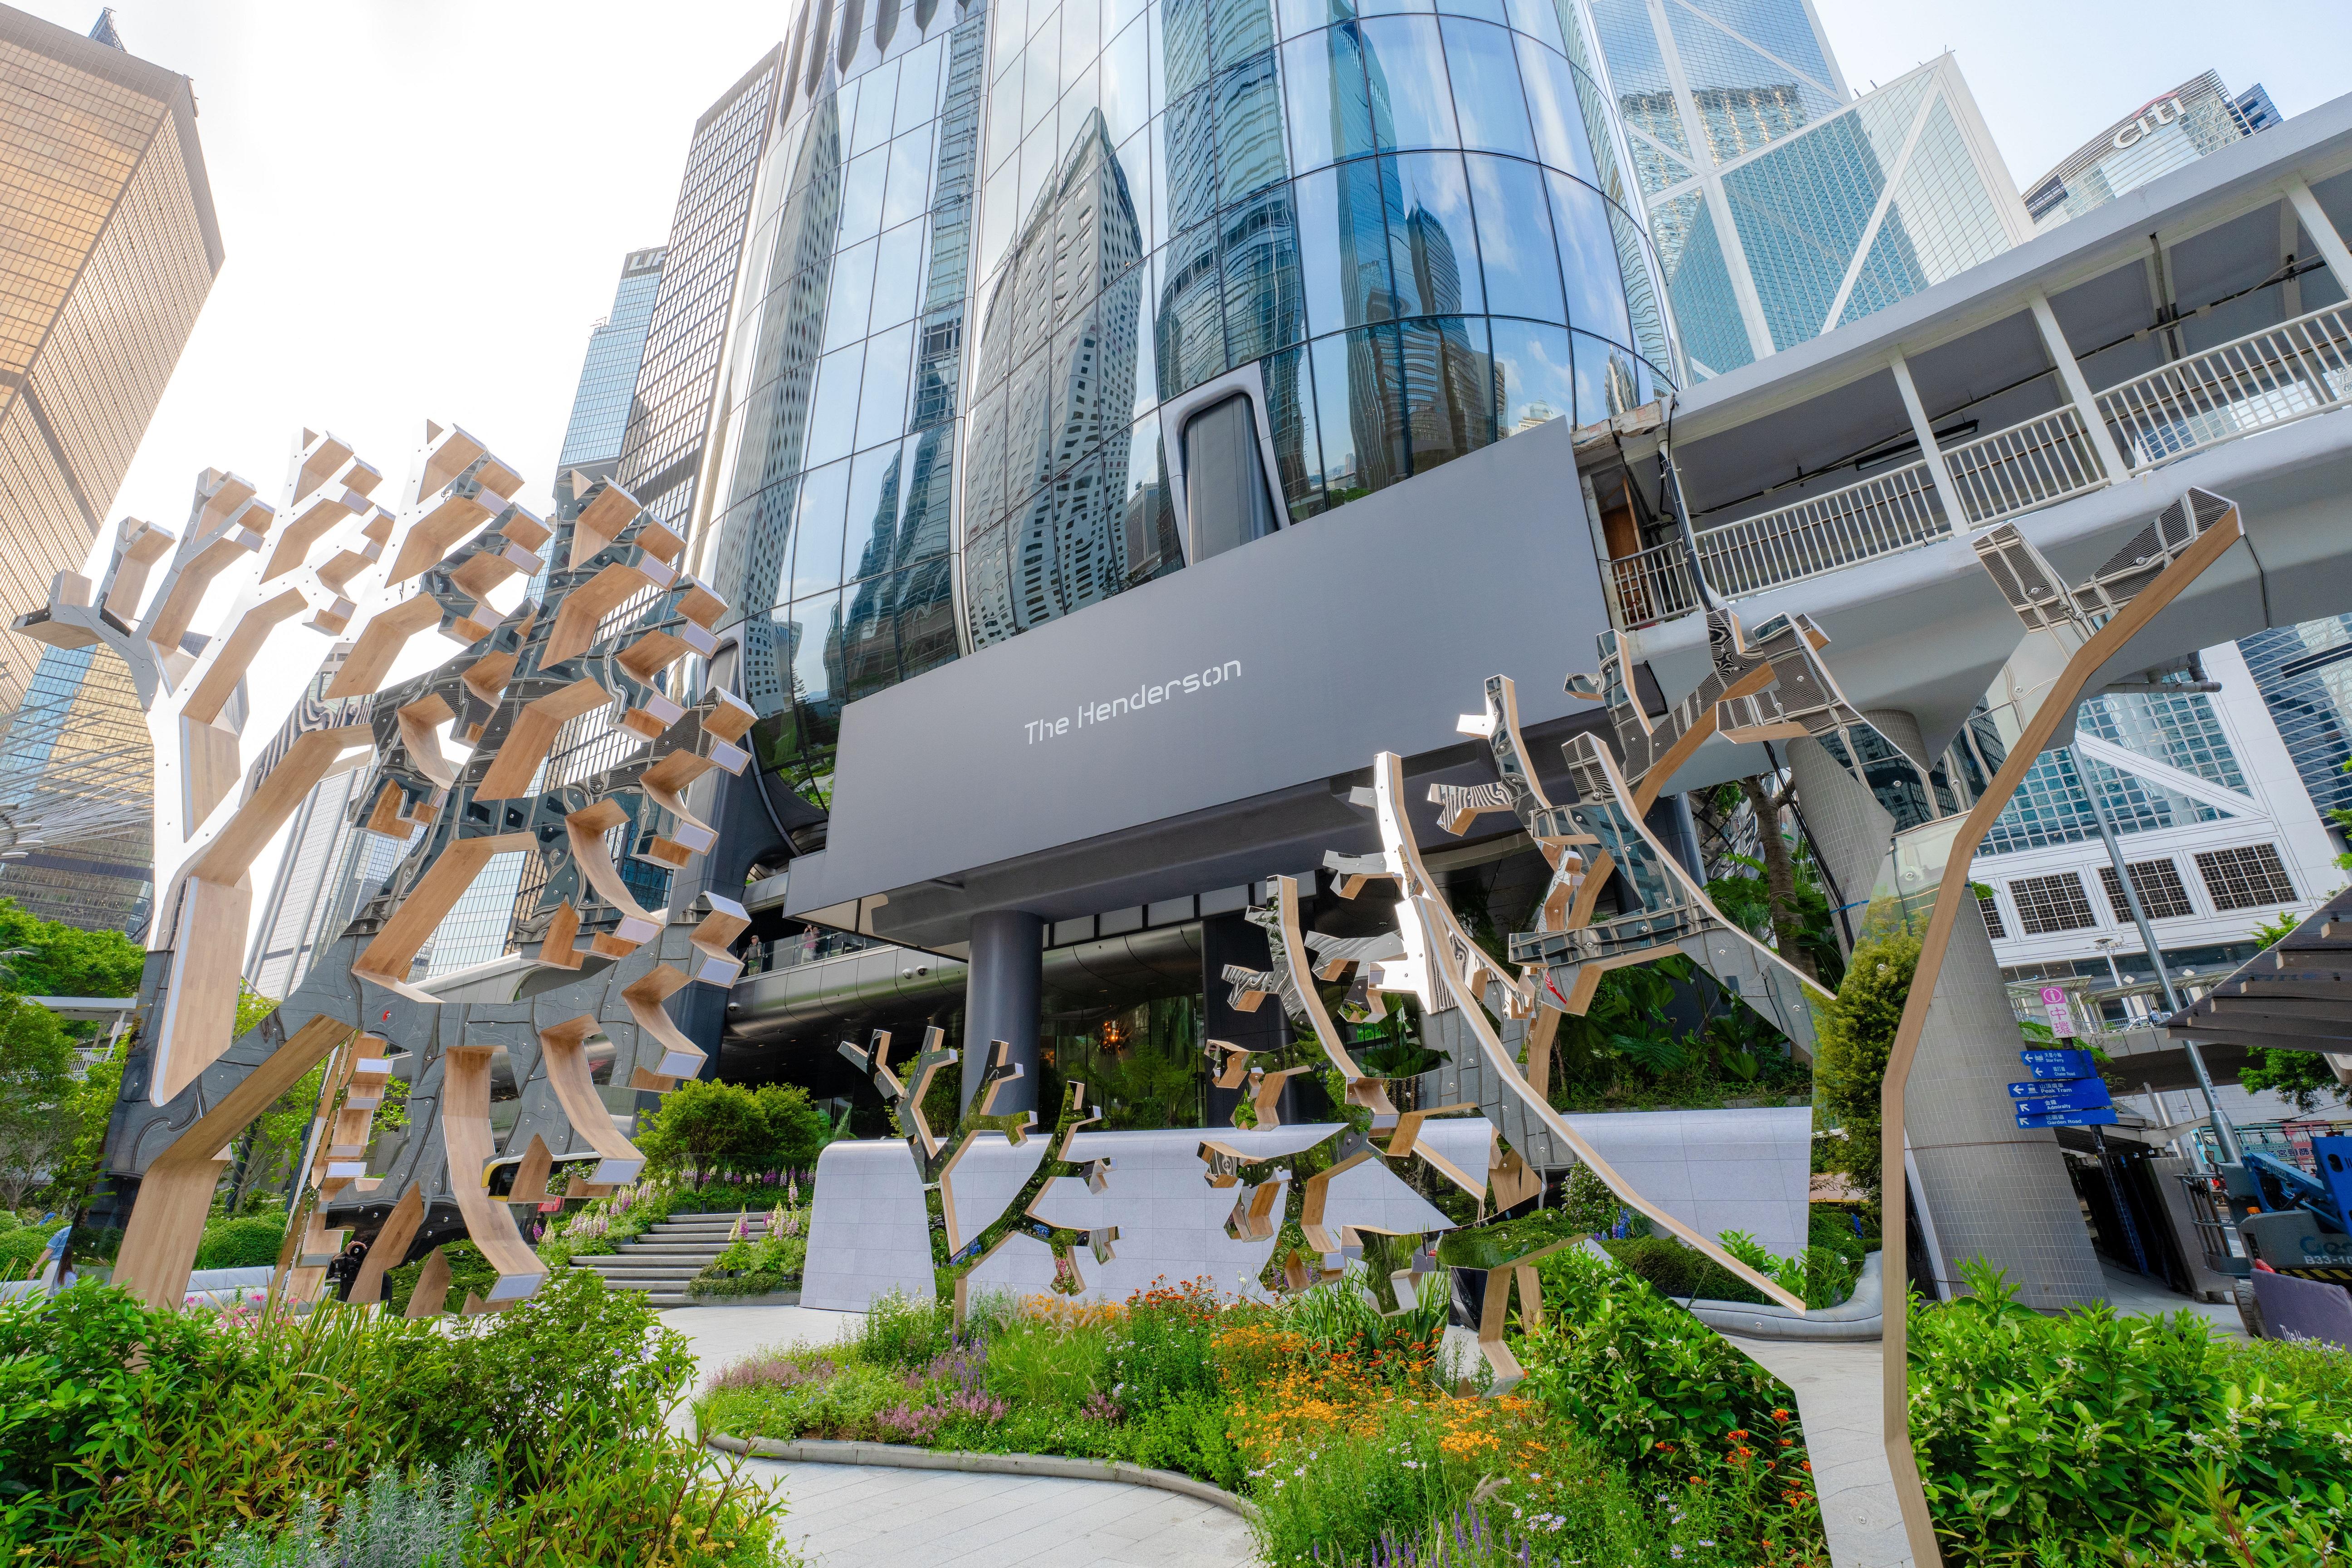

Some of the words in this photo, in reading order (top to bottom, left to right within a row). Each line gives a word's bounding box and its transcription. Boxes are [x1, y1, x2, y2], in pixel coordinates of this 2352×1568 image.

[2112, 97, 2186, 149] citi
[1024, 717, 1069, 745] The
[1078, 660, 1241, 729] Henderson
[2050, 1007, 2073, 1034] 中環
